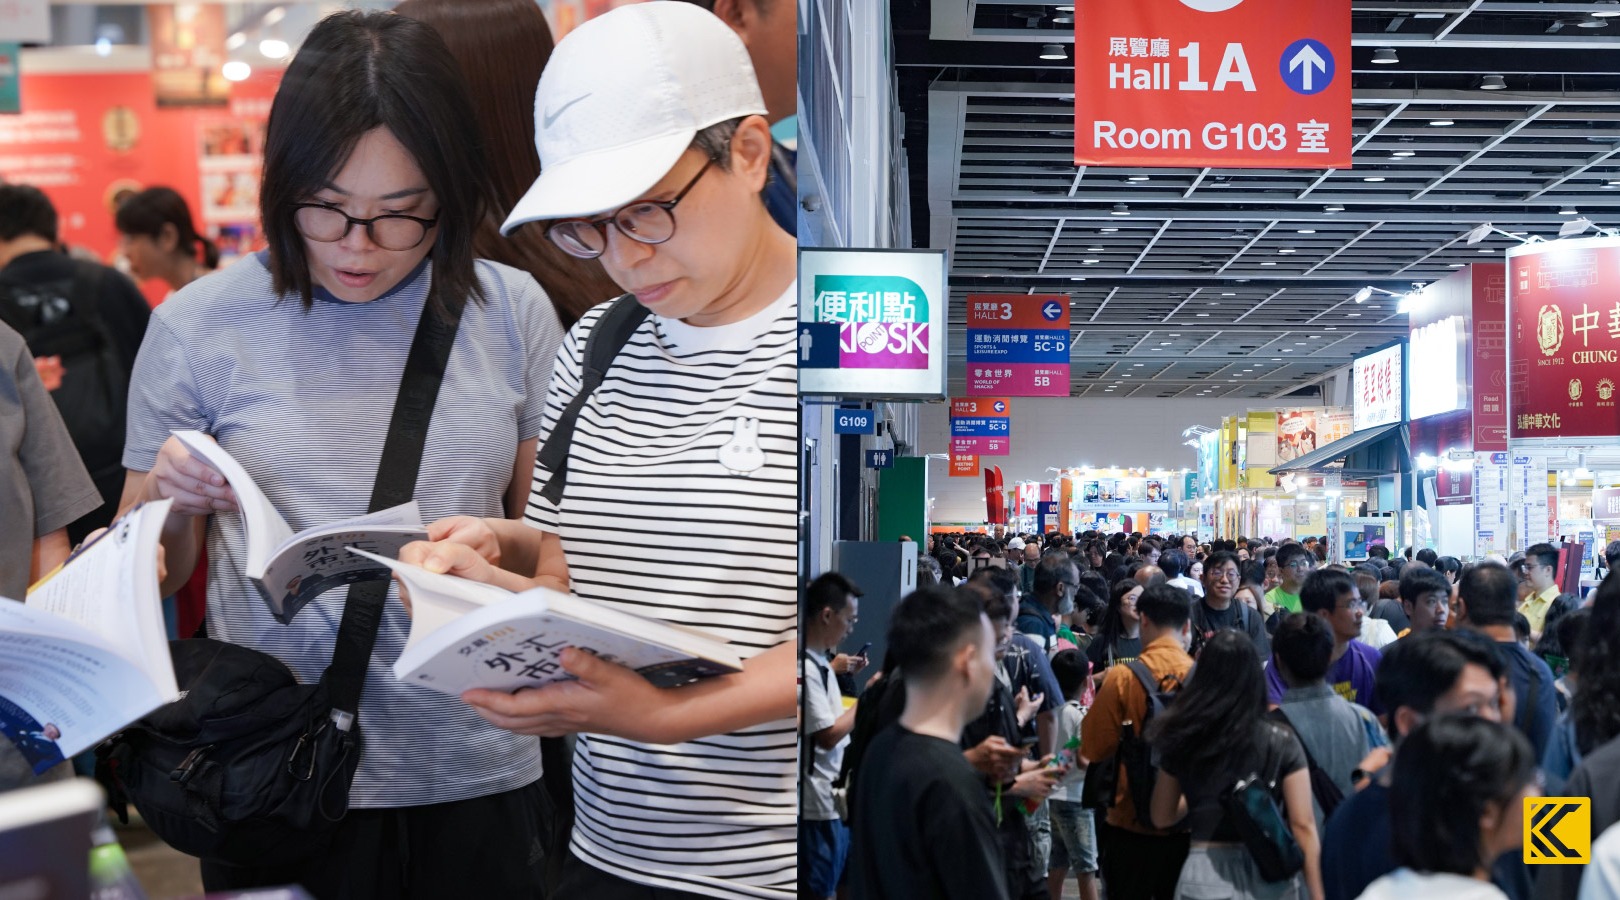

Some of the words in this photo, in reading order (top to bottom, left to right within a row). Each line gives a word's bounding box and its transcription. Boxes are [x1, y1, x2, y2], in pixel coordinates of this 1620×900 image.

[1109, 37, 1170, 58] 展覽廳
[1109, 62, 1170, 90] Hall
[1178, 41, 1257, 92] 1A
[1093, 120, 1191, 150] Room
[1202, 121, 1287, 151] G103
[1296, 118, 1330, 153] 室
[815, 290, 917, 323] 便利點
[974, 312, 999, 320] HALL
[1000, 303, 1012, 320] 3
[860, 325, 885, 350] POINT
[1034, 342, 1065, 351] 5C-D
[1572, 350, 1618, 364] CHUNG
[974, 369, 1012, 377] 零食世界
[1034, 377, 1050, 386] 5B
[970, 402, 977, 412] 3
[840, 416, 867, 427] G109
[1517, 413, 1560, 429] 弘揚中華文化
